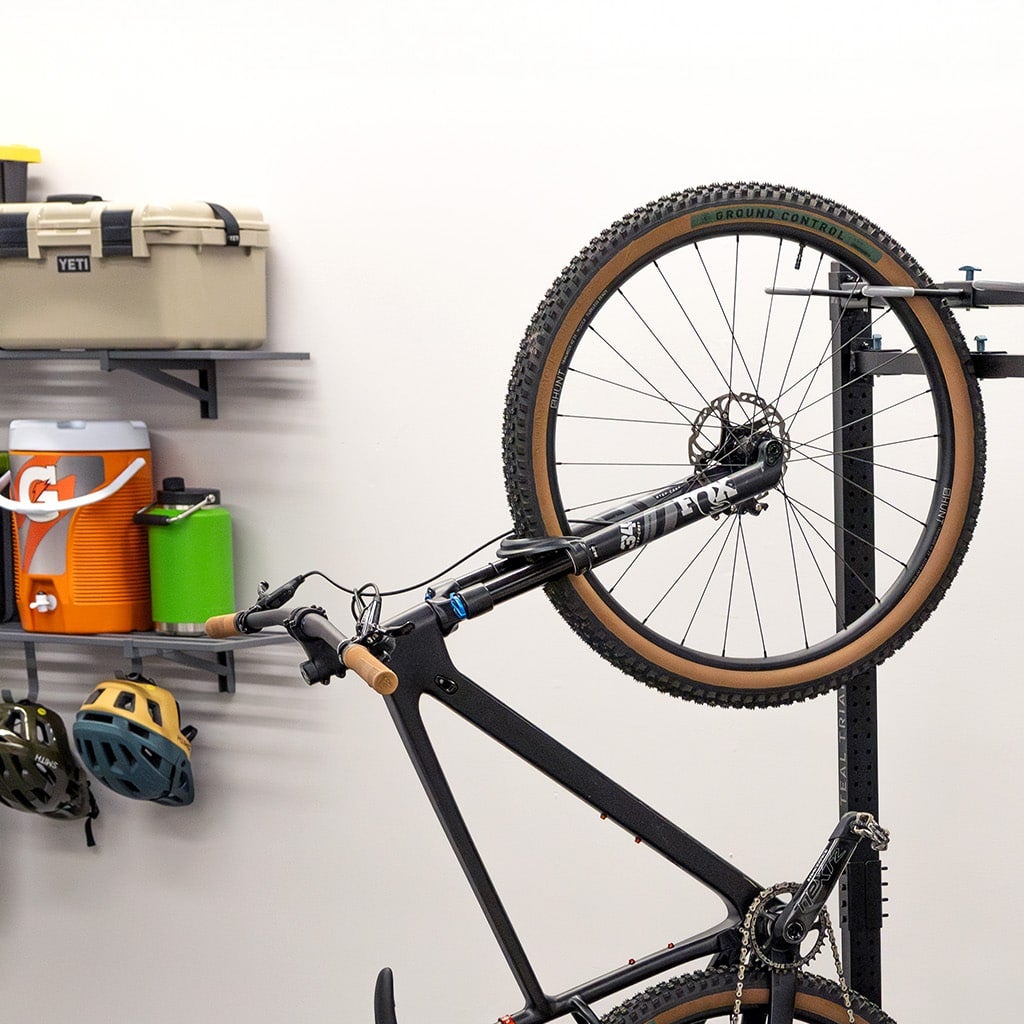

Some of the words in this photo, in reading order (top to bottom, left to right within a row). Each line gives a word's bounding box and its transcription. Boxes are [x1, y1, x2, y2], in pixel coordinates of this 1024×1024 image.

[715, 208, 775, 221] GROUND
[781, 211, 845, 241] CONTROL
[58, 258, 89, 271] YETI
[19, 465, 60, 523] G
[838, 685, 848, 743] TRIA
[34, 753, 60, 770] SMITH
[839, 752, 848, 804] TEAL
